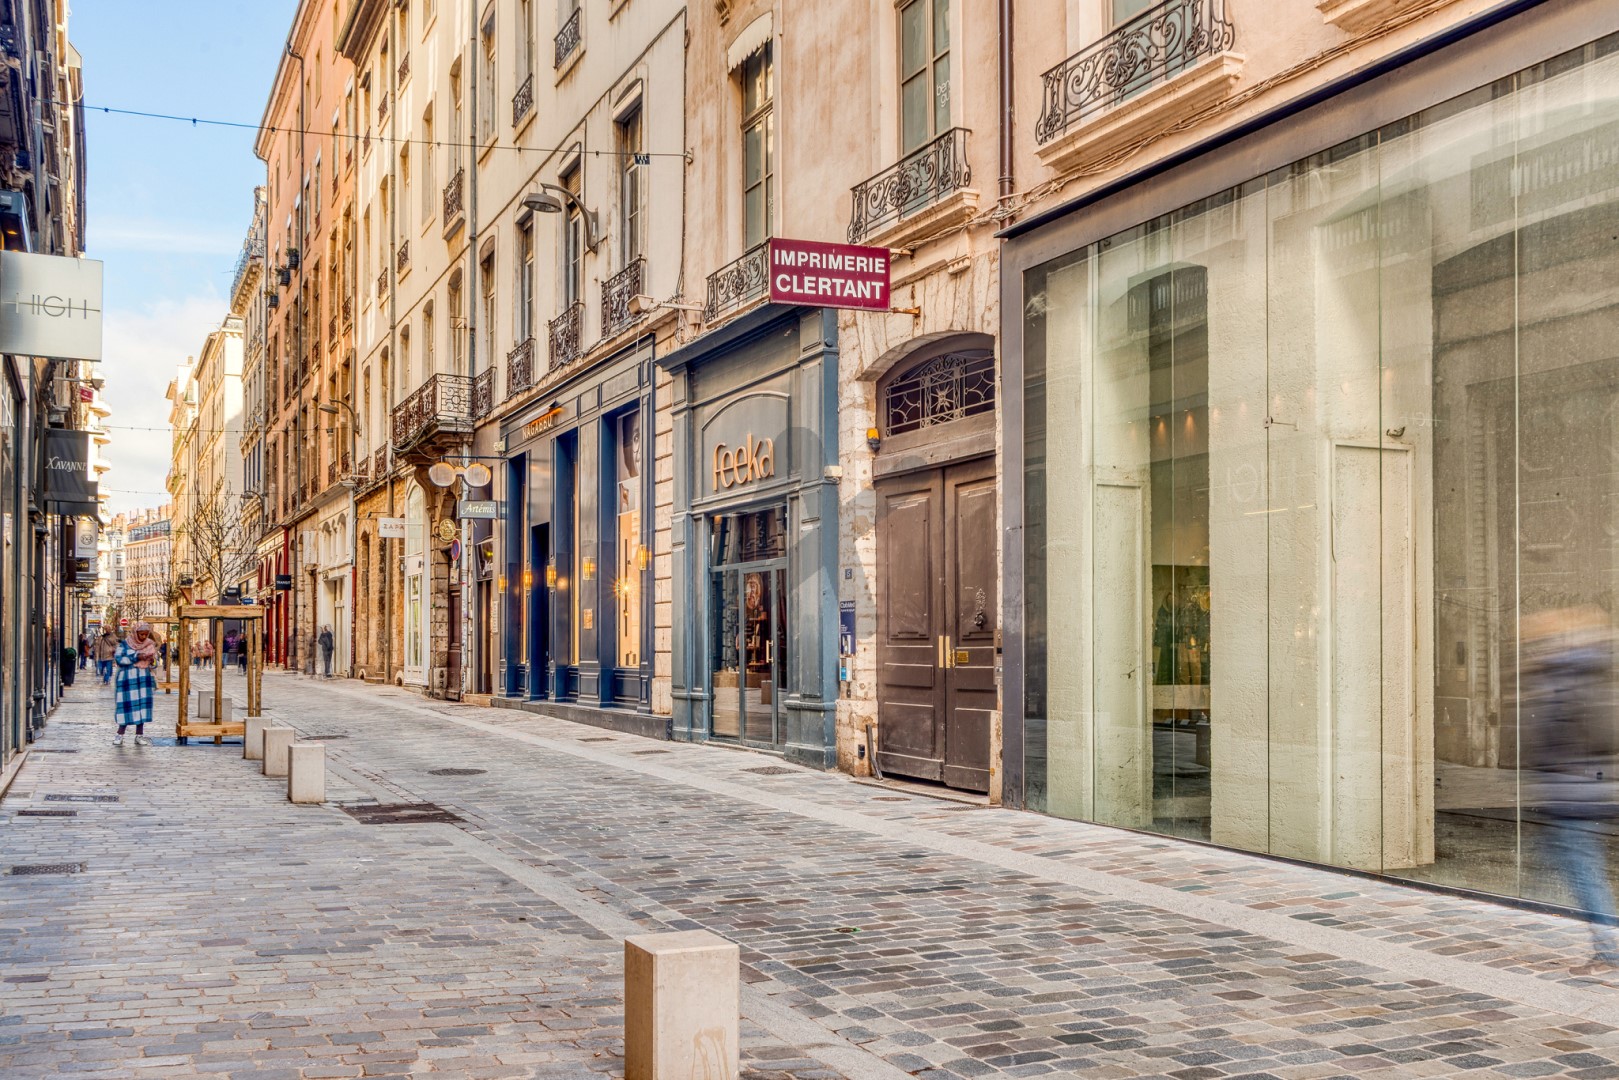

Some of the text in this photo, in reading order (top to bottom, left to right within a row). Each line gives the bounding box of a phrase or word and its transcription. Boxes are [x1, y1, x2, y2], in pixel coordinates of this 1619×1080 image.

[774, 249, 886, 274] IMPRIMERIE
[775, 274, 885, 300] CLERTANT
[15, 292, 87, 320] HIGH
[45, 456, 87, 473] XAVANNE
[713, 432, 775, 491] feeka
[461, 503, 496, 515] Artémis
